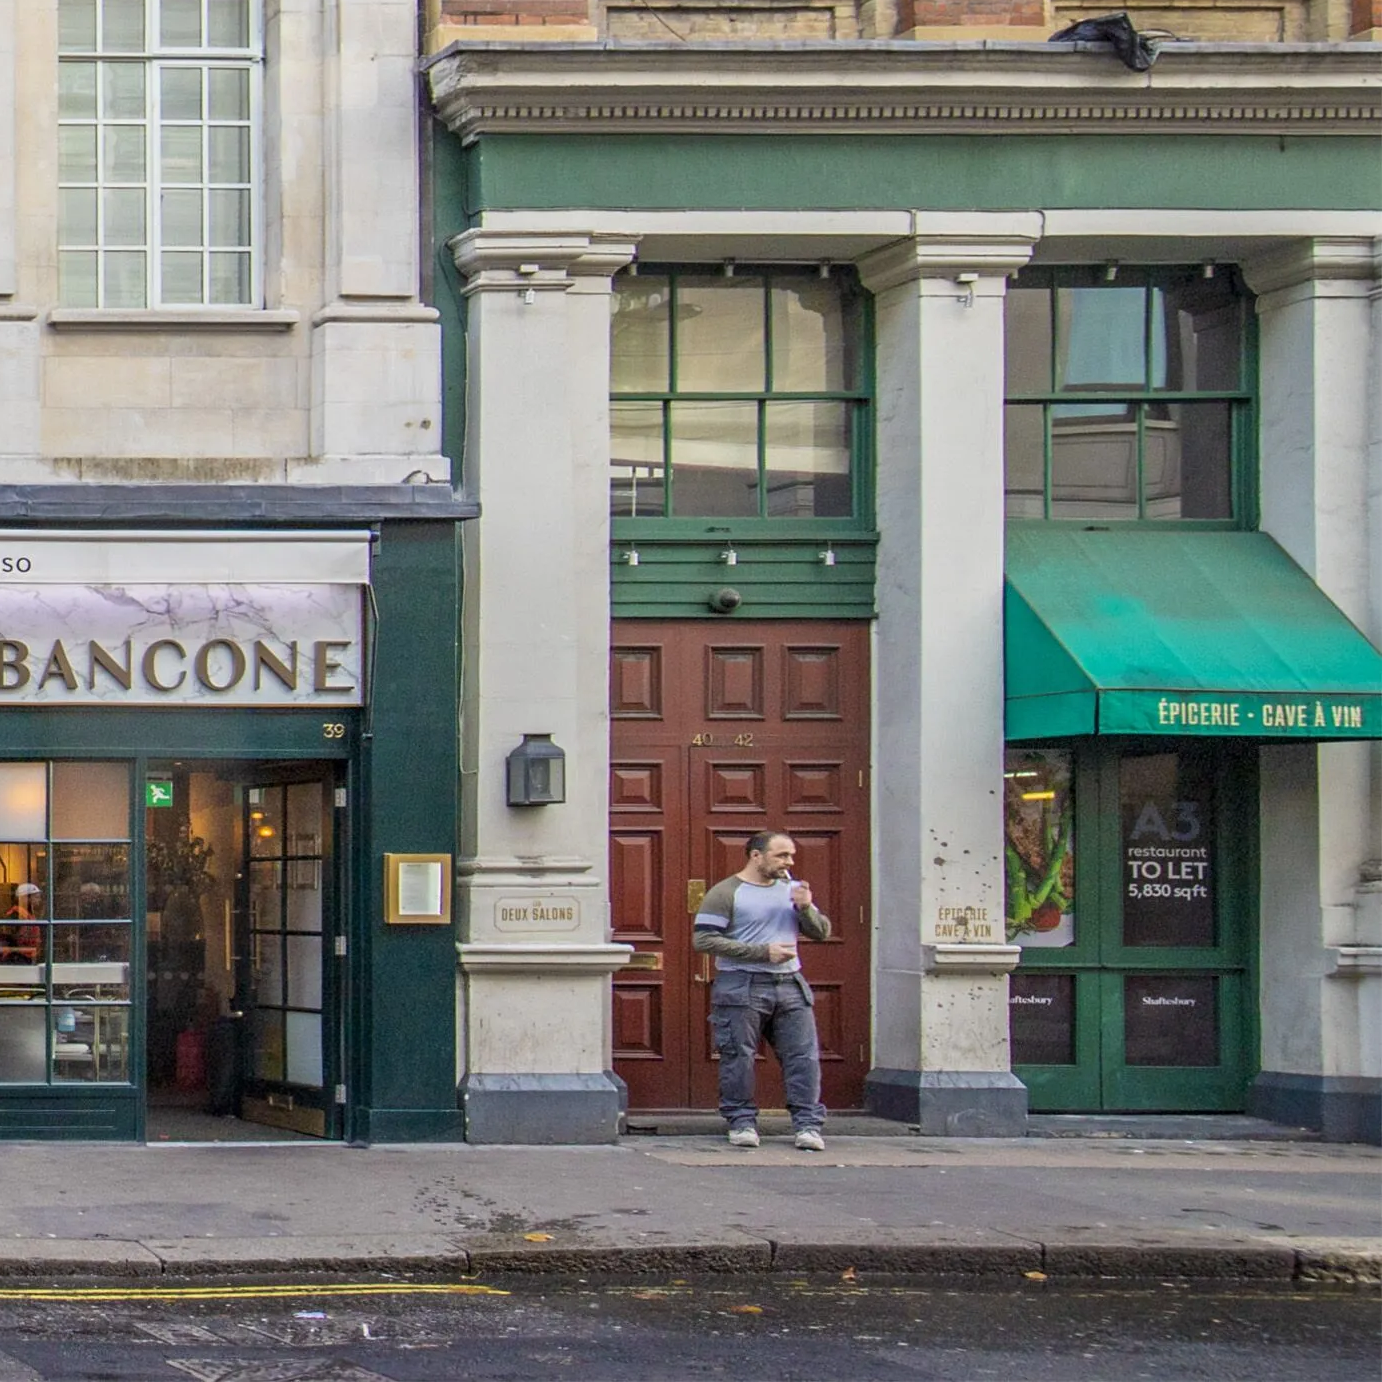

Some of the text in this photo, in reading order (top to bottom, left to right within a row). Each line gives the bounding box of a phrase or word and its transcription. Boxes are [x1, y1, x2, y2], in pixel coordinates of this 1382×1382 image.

[1158, 698, 1240, 726] ÉPICERIE
[1262, 704, 1308, 727] CAVE
[1332, 705, 1362, 728] VIN
[322, 723, 345, 738] 39
[692, 732, 713, 746] 40
[734, 732, 754, 747] 42
[1128, 847, 1207, 858] restaurant
[1128, 861, 1208, 879] TO LET
[1128, 883, 1171, 899] 5,830
[501, 907, 573, 921] DEUX SALONS
[1142, 996, 1196, 1006] Shaftesbury
